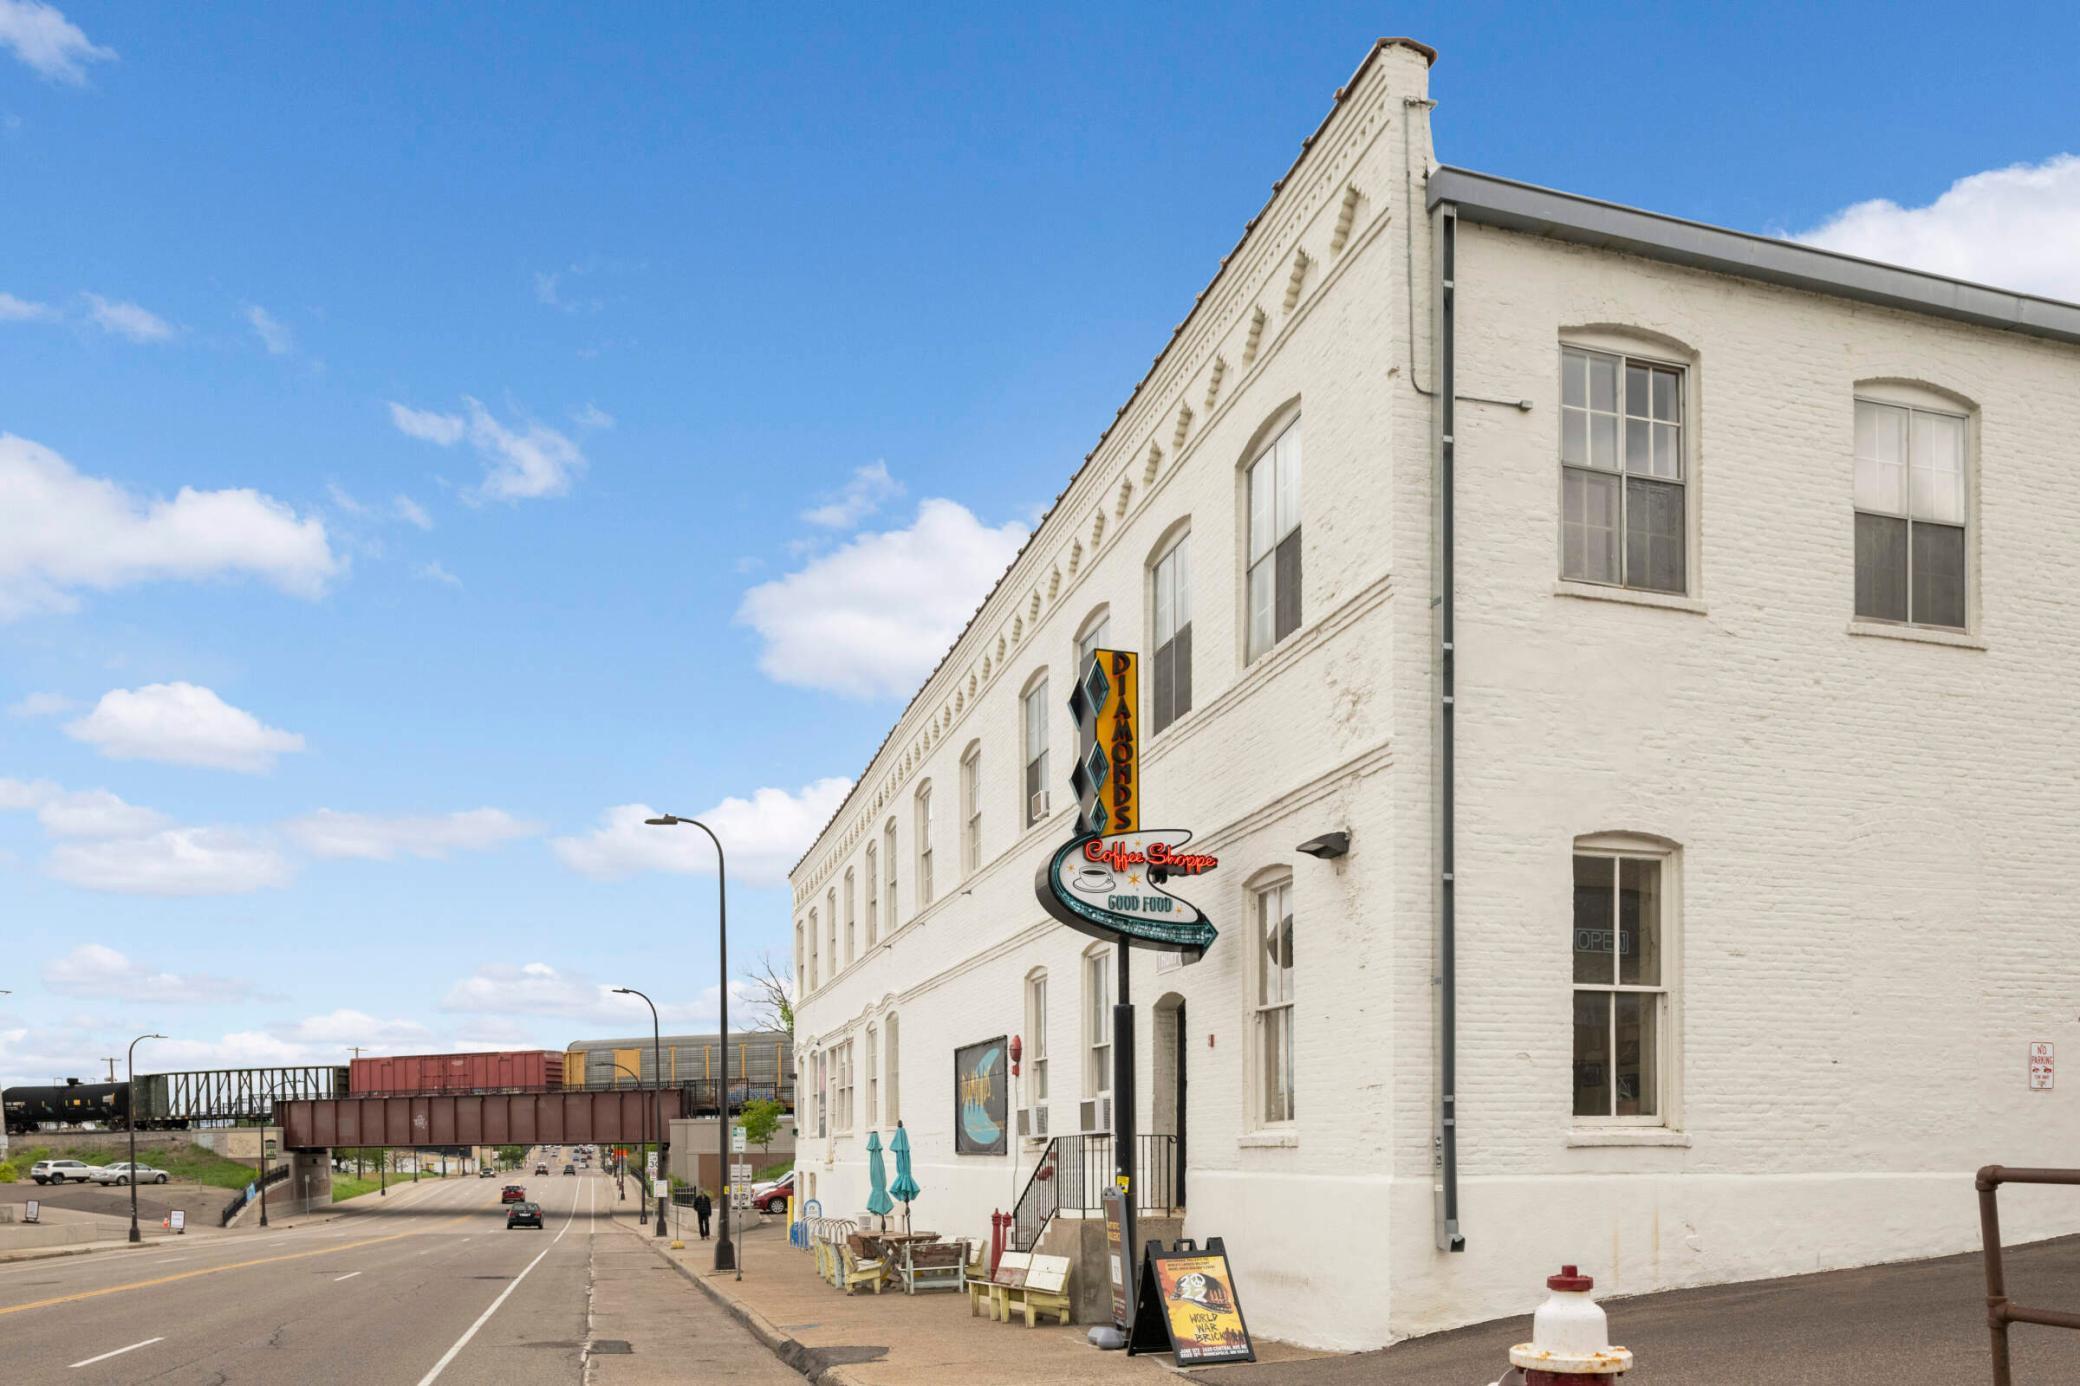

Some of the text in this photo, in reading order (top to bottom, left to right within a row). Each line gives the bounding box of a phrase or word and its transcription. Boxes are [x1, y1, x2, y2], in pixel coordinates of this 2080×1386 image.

[1111, 652, 1133, 830] DIAMONDS
[1083, 839, 1218, 874] Coffee Shoppe
[1108, 895, 1173, 912] GOOD FOOD
[2037, 1045, 2047, 1055] NO
[2032, 1056, 2053, 1065] PARKING
[1189, 1313, 1218, 1323] WORLD
[1196, 1323, 1217, 1333] WAR
[1194, 1332, 1224, 1343] BRICK
